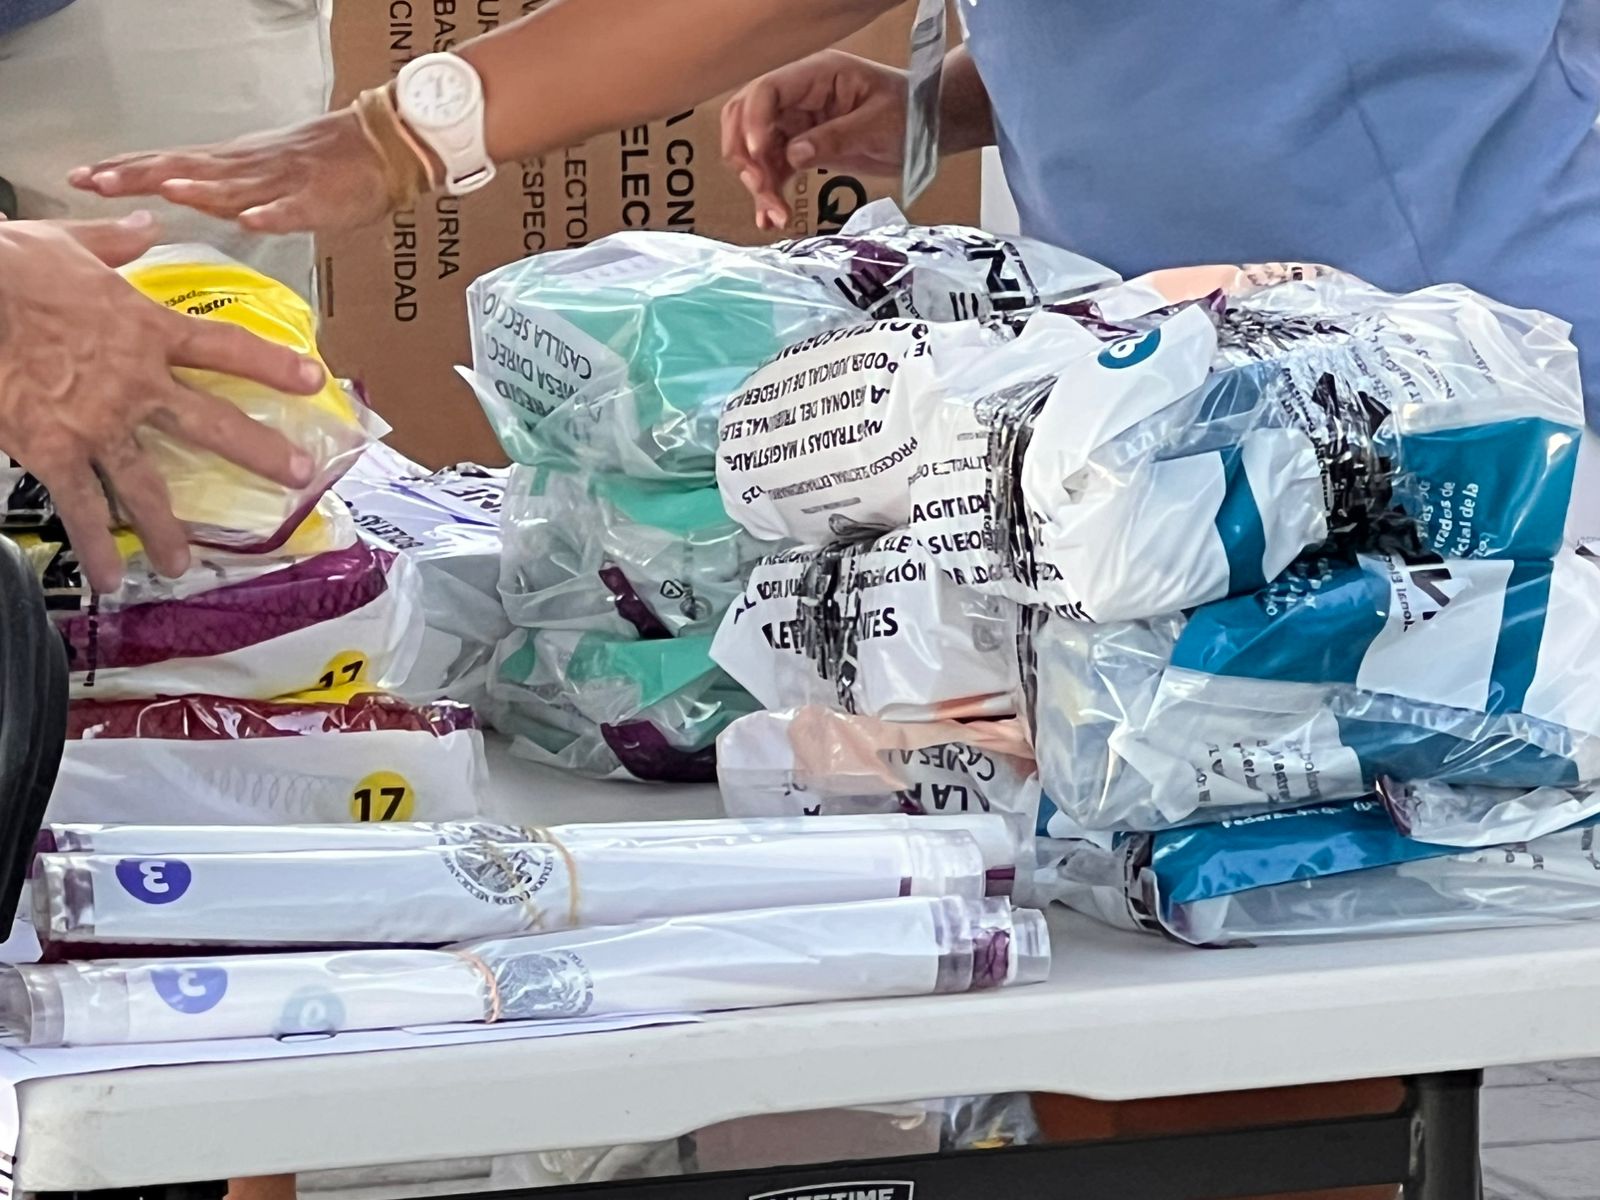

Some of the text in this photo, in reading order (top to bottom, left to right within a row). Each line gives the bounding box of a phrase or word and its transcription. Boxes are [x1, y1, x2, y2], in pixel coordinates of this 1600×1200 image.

[620, 124, 651, 231] ELEC
[666, 139, 695, 234] CON
[436, 195, 459, 280] URNA
[534, 324, 592, 379] CASILLA
[319, 660, 363, 688] 17
[354, 786, 405, 822] 17
[139, 860, 169, 893] 3
